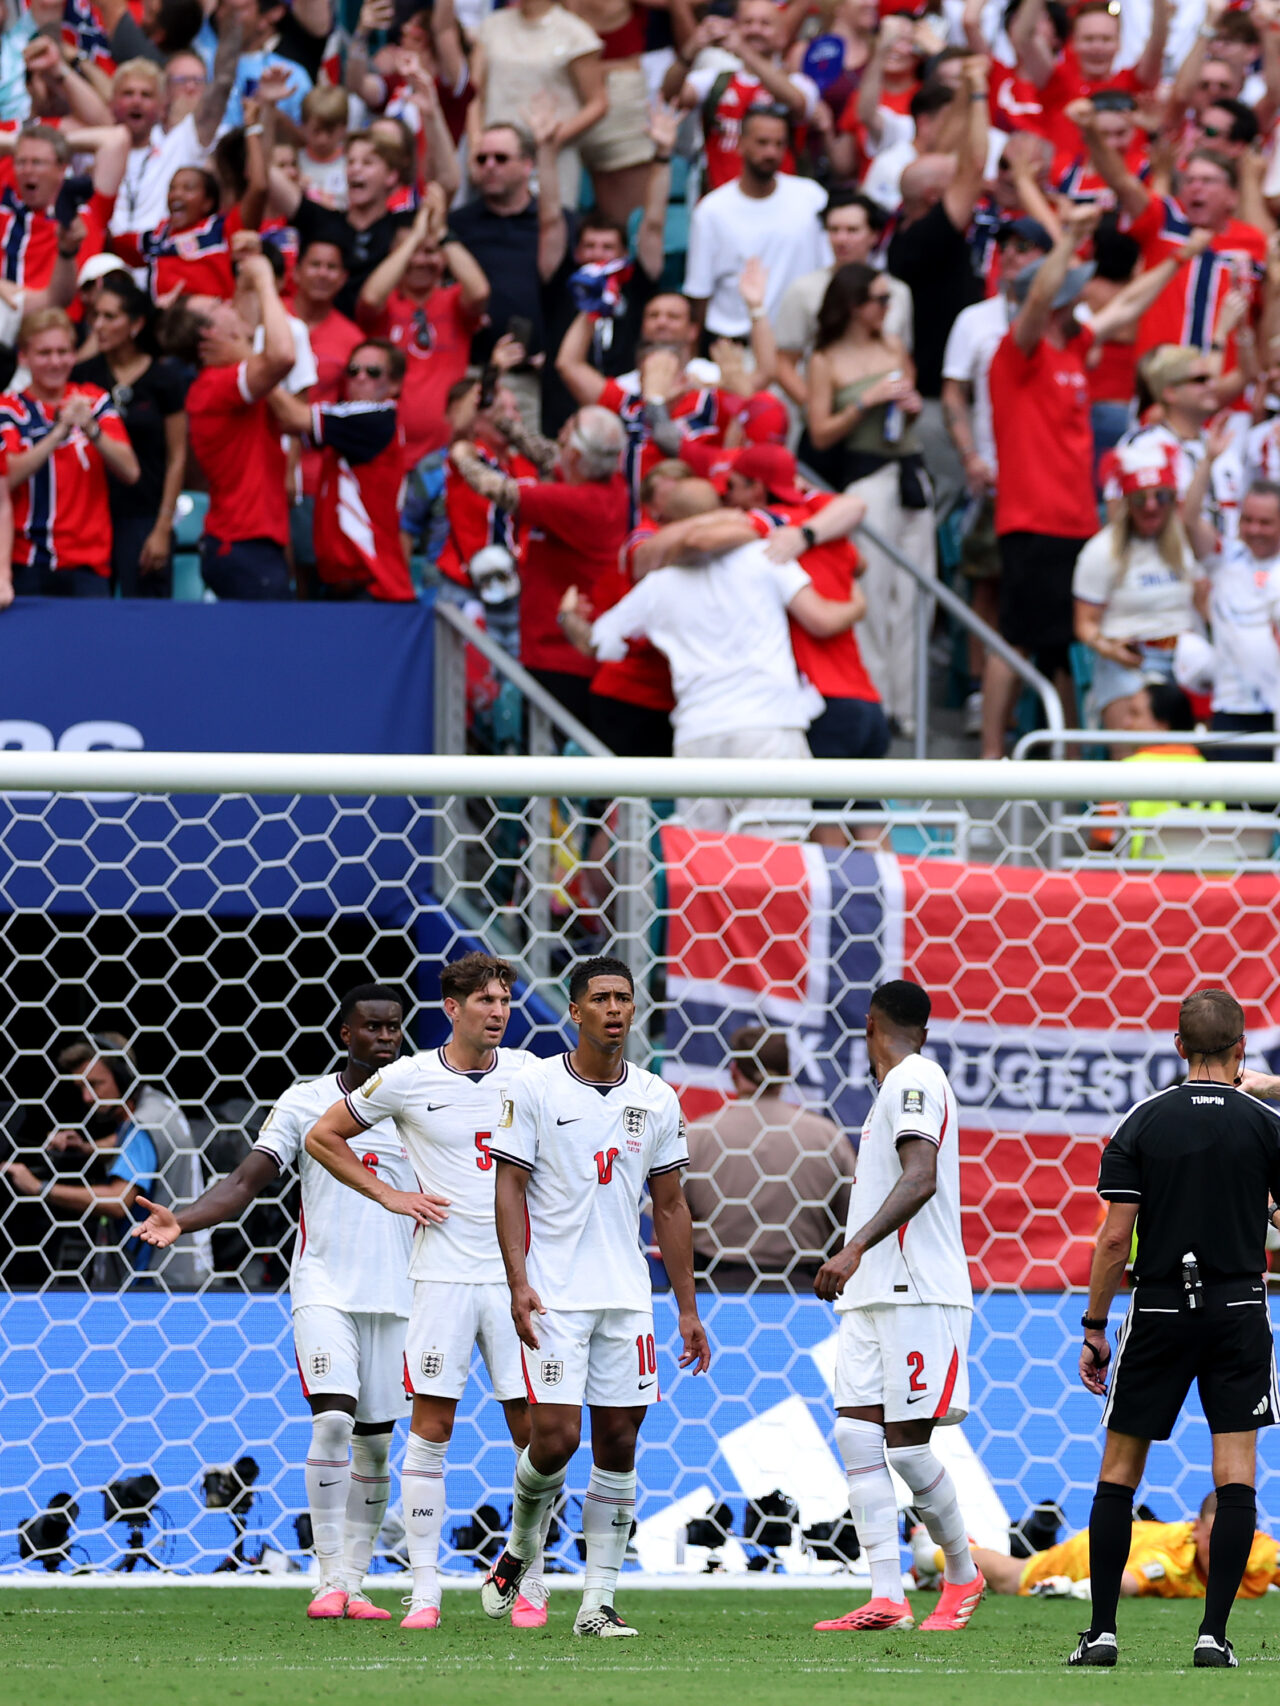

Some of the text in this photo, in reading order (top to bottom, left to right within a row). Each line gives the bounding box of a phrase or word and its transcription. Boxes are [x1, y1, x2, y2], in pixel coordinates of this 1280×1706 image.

[1190, 1095, 1224, 1106] TURPIN
[475, 1132, 492, 1170] 5
[594, 1148, 618, 1184] 10
[636, 1333, 656, 1375] 10
[907, 1351, 927, 1391] 2
[412, 1508, 434, 1517] ENG
